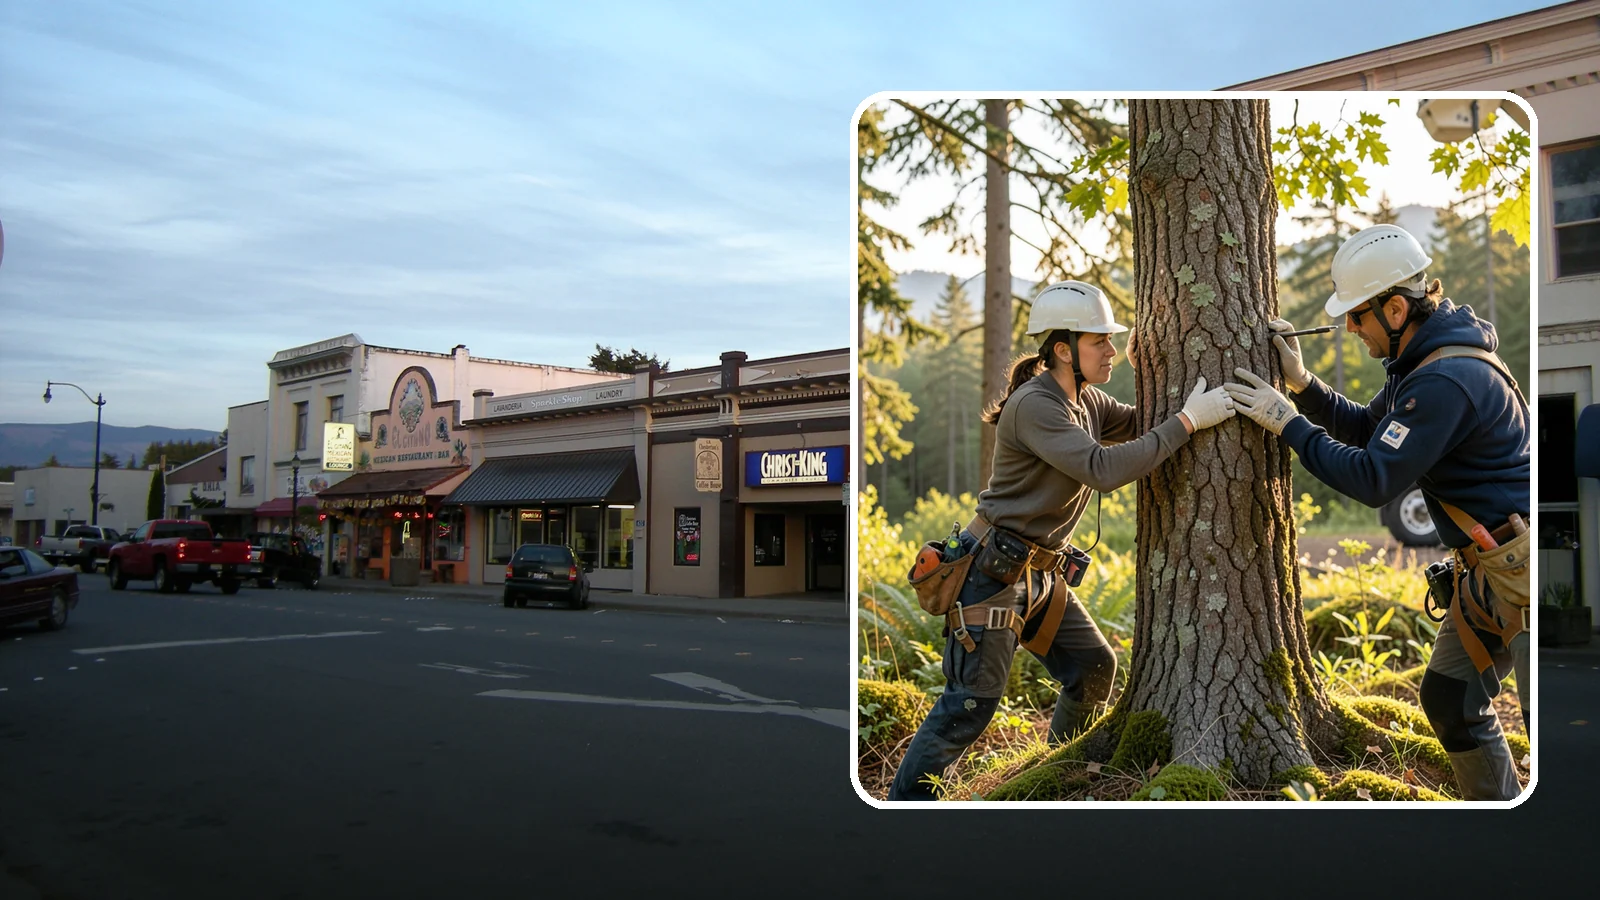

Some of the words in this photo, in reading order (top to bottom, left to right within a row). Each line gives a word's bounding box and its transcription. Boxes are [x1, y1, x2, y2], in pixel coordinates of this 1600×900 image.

[562, 394, 582, 405] Shop
[595, 388, 623, 400] LAUNDRY
[493, 401, 522, 412] LAVANDERIA
[373, 455, 396, 464] MEXICAN
[397, 451, 434, 462] RESTAURANT
[437, 450, 450, 459] BAR
[761, 452, 797, 478] CHRIST
[799, 450, 827, 476] KING
